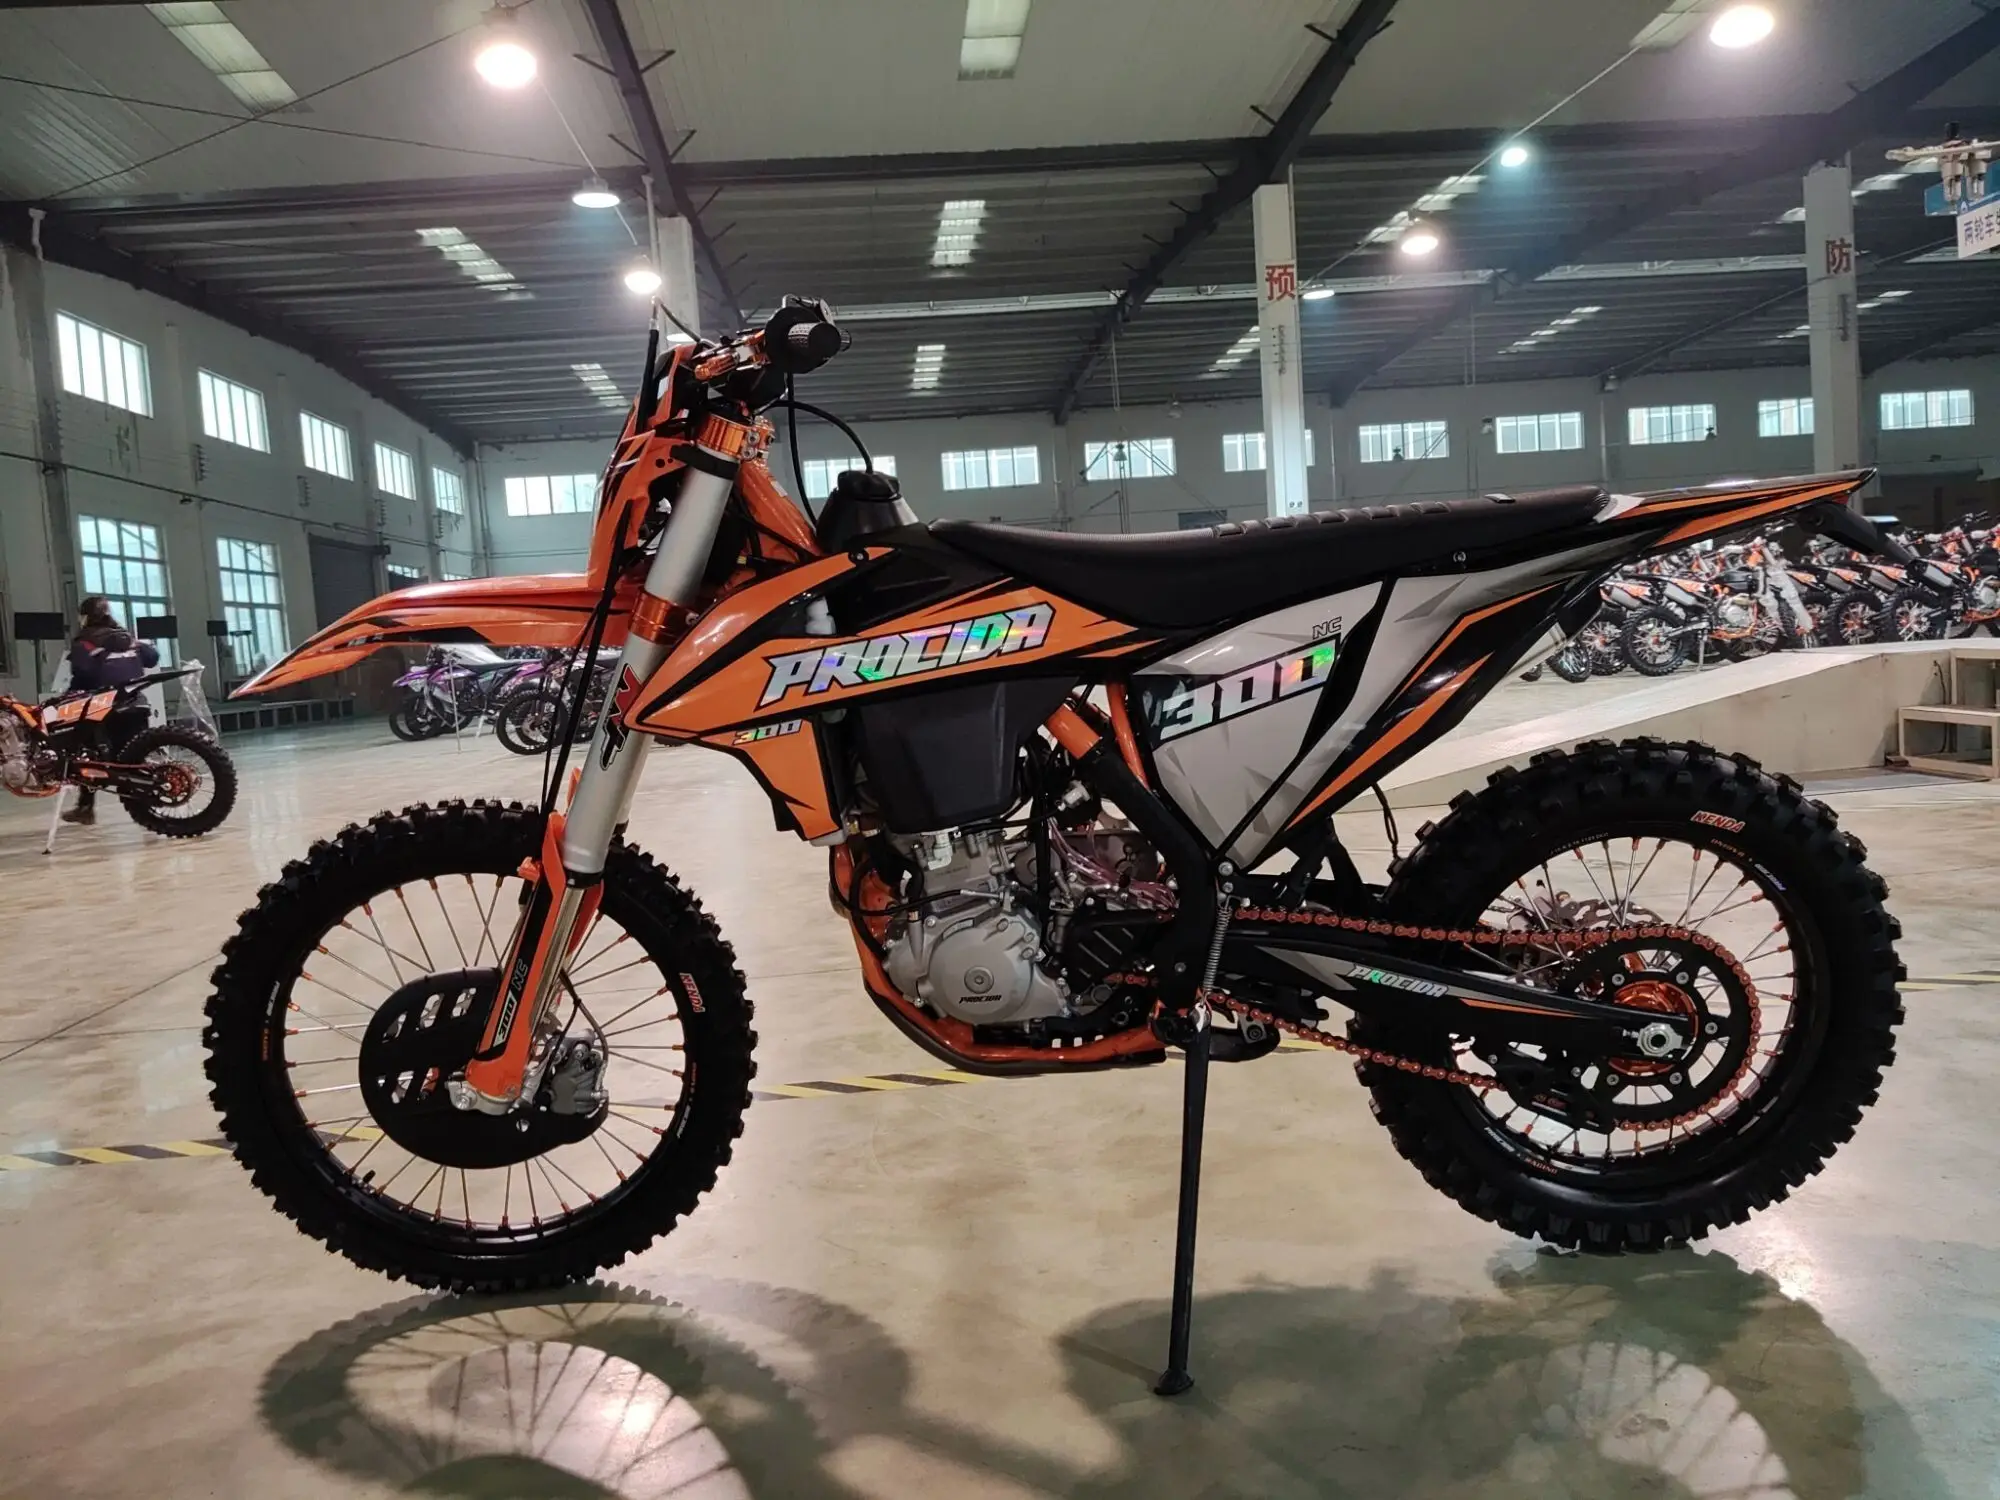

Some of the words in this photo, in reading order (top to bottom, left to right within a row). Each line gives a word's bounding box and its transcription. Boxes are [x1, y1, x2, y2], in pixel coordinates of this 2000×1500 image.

[1825, 238, 1852, 275] 防
[1265, 264, 1296, 301] 预
[1312, 616, 1342, 639] NC
[754, 602, 1056, 712] PROCIDA
[1158, 635, 1340, 742] 300
[732, 719, 802, 745] 300
[1690, 810, 1746, 833] KENDA
[511, 958, 528, 991] NC
[1350, 964, 1449, 998] PROCIDA
